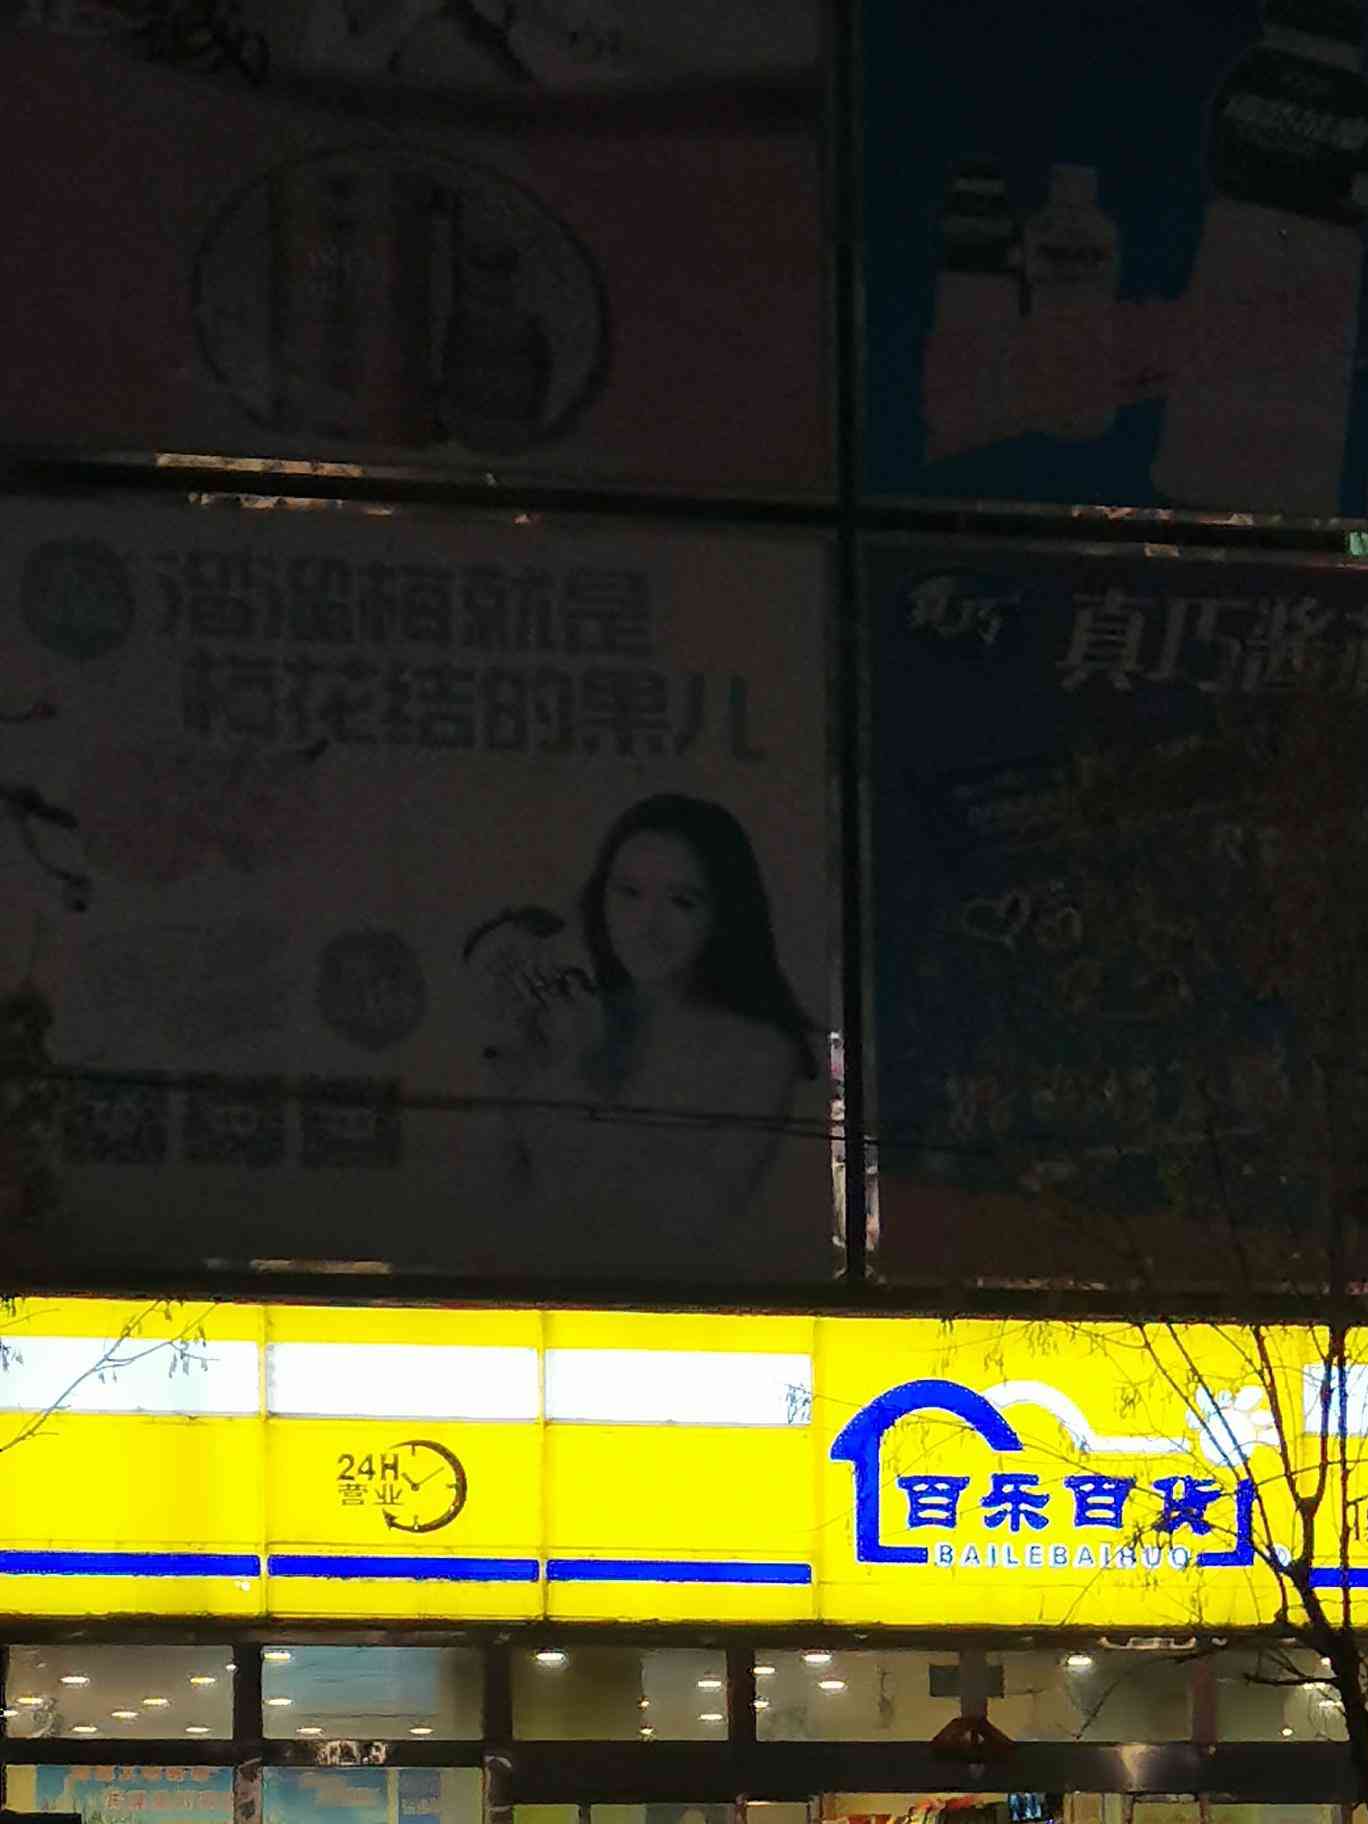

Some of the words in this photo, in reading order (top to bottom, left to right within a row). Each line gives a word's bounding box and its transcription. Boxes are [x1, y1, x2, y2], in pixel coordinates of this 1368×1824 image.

[337, 1453, 399, 1481] 24H
[337, 1483, 404, 1507] 营业
[896, 1473, 1222, 1534] 百乐百货
[936, 1543, 1193, 1569] BAILEBAIHUO
